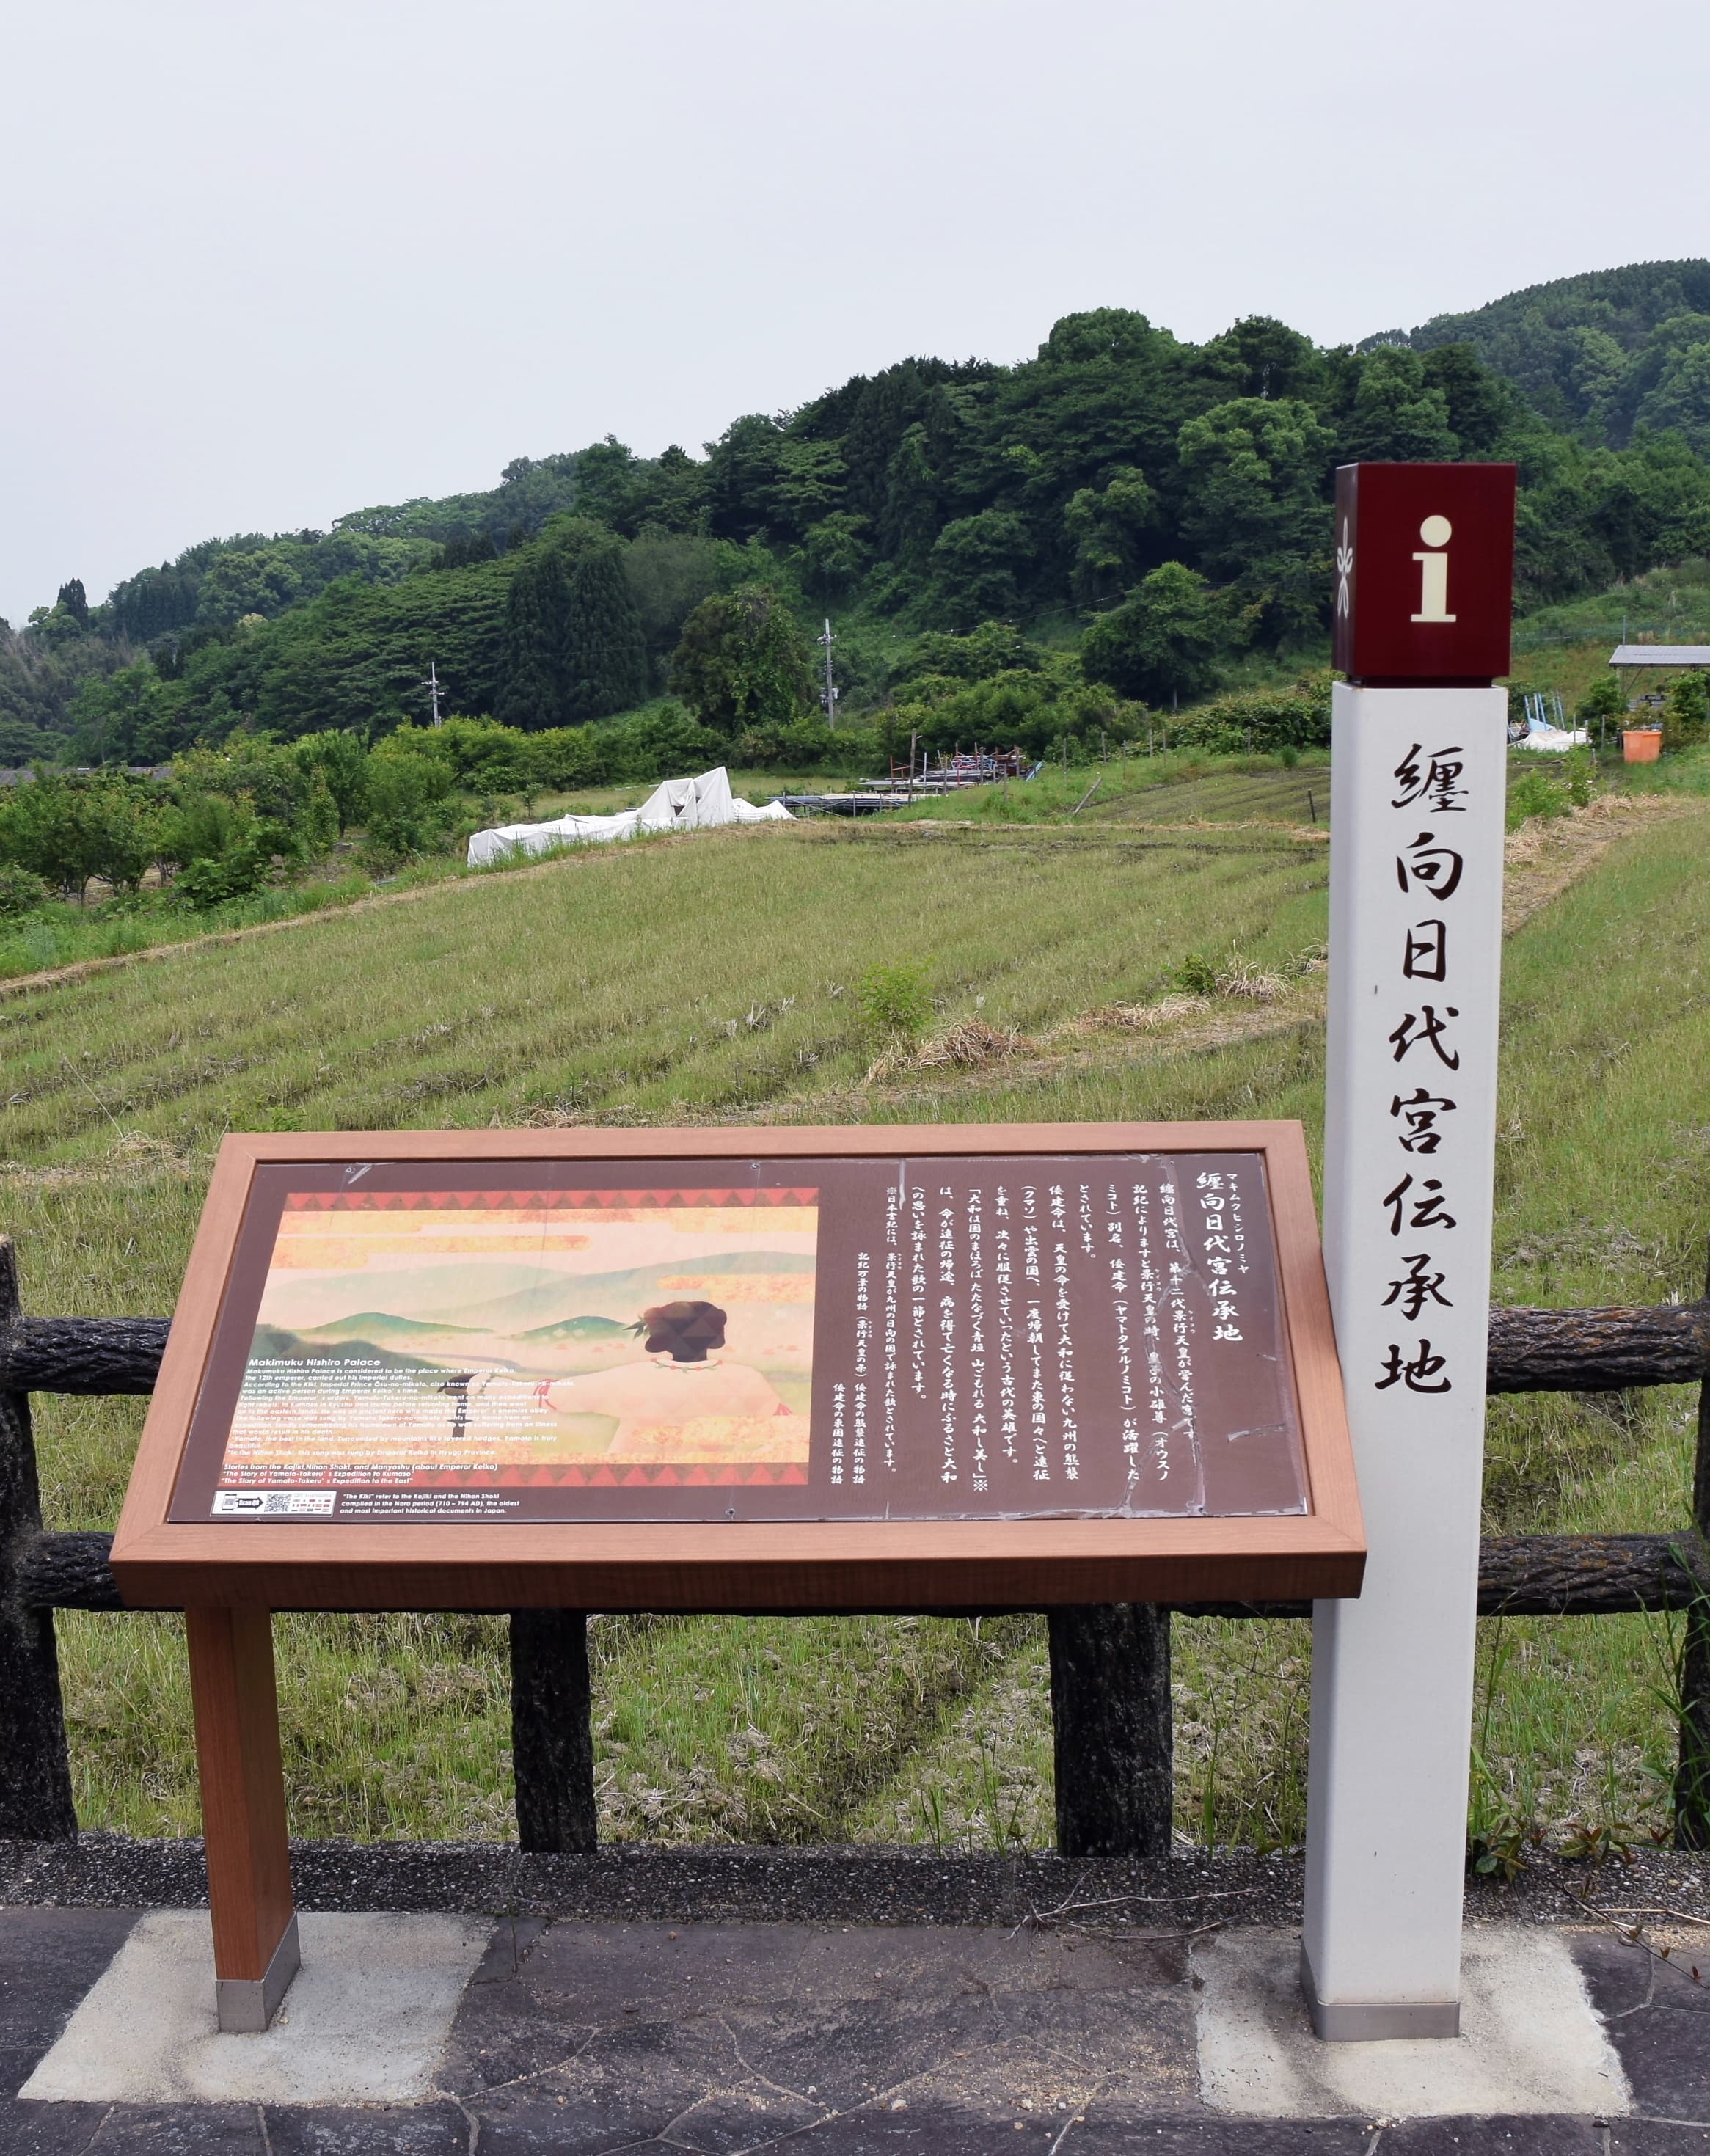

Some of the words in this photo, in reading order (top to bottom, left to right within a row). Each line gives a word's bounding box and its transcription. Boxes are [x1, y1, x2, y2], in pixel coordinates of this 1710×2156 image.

[1375, 743, 1469, 1393] 纏向日代宮伝承地
[1196, 1172, 1243, 1342] 纏向日代宮伝承地
[1226, 1173, 1249, 1274] マキムクヒシロノミヤ
